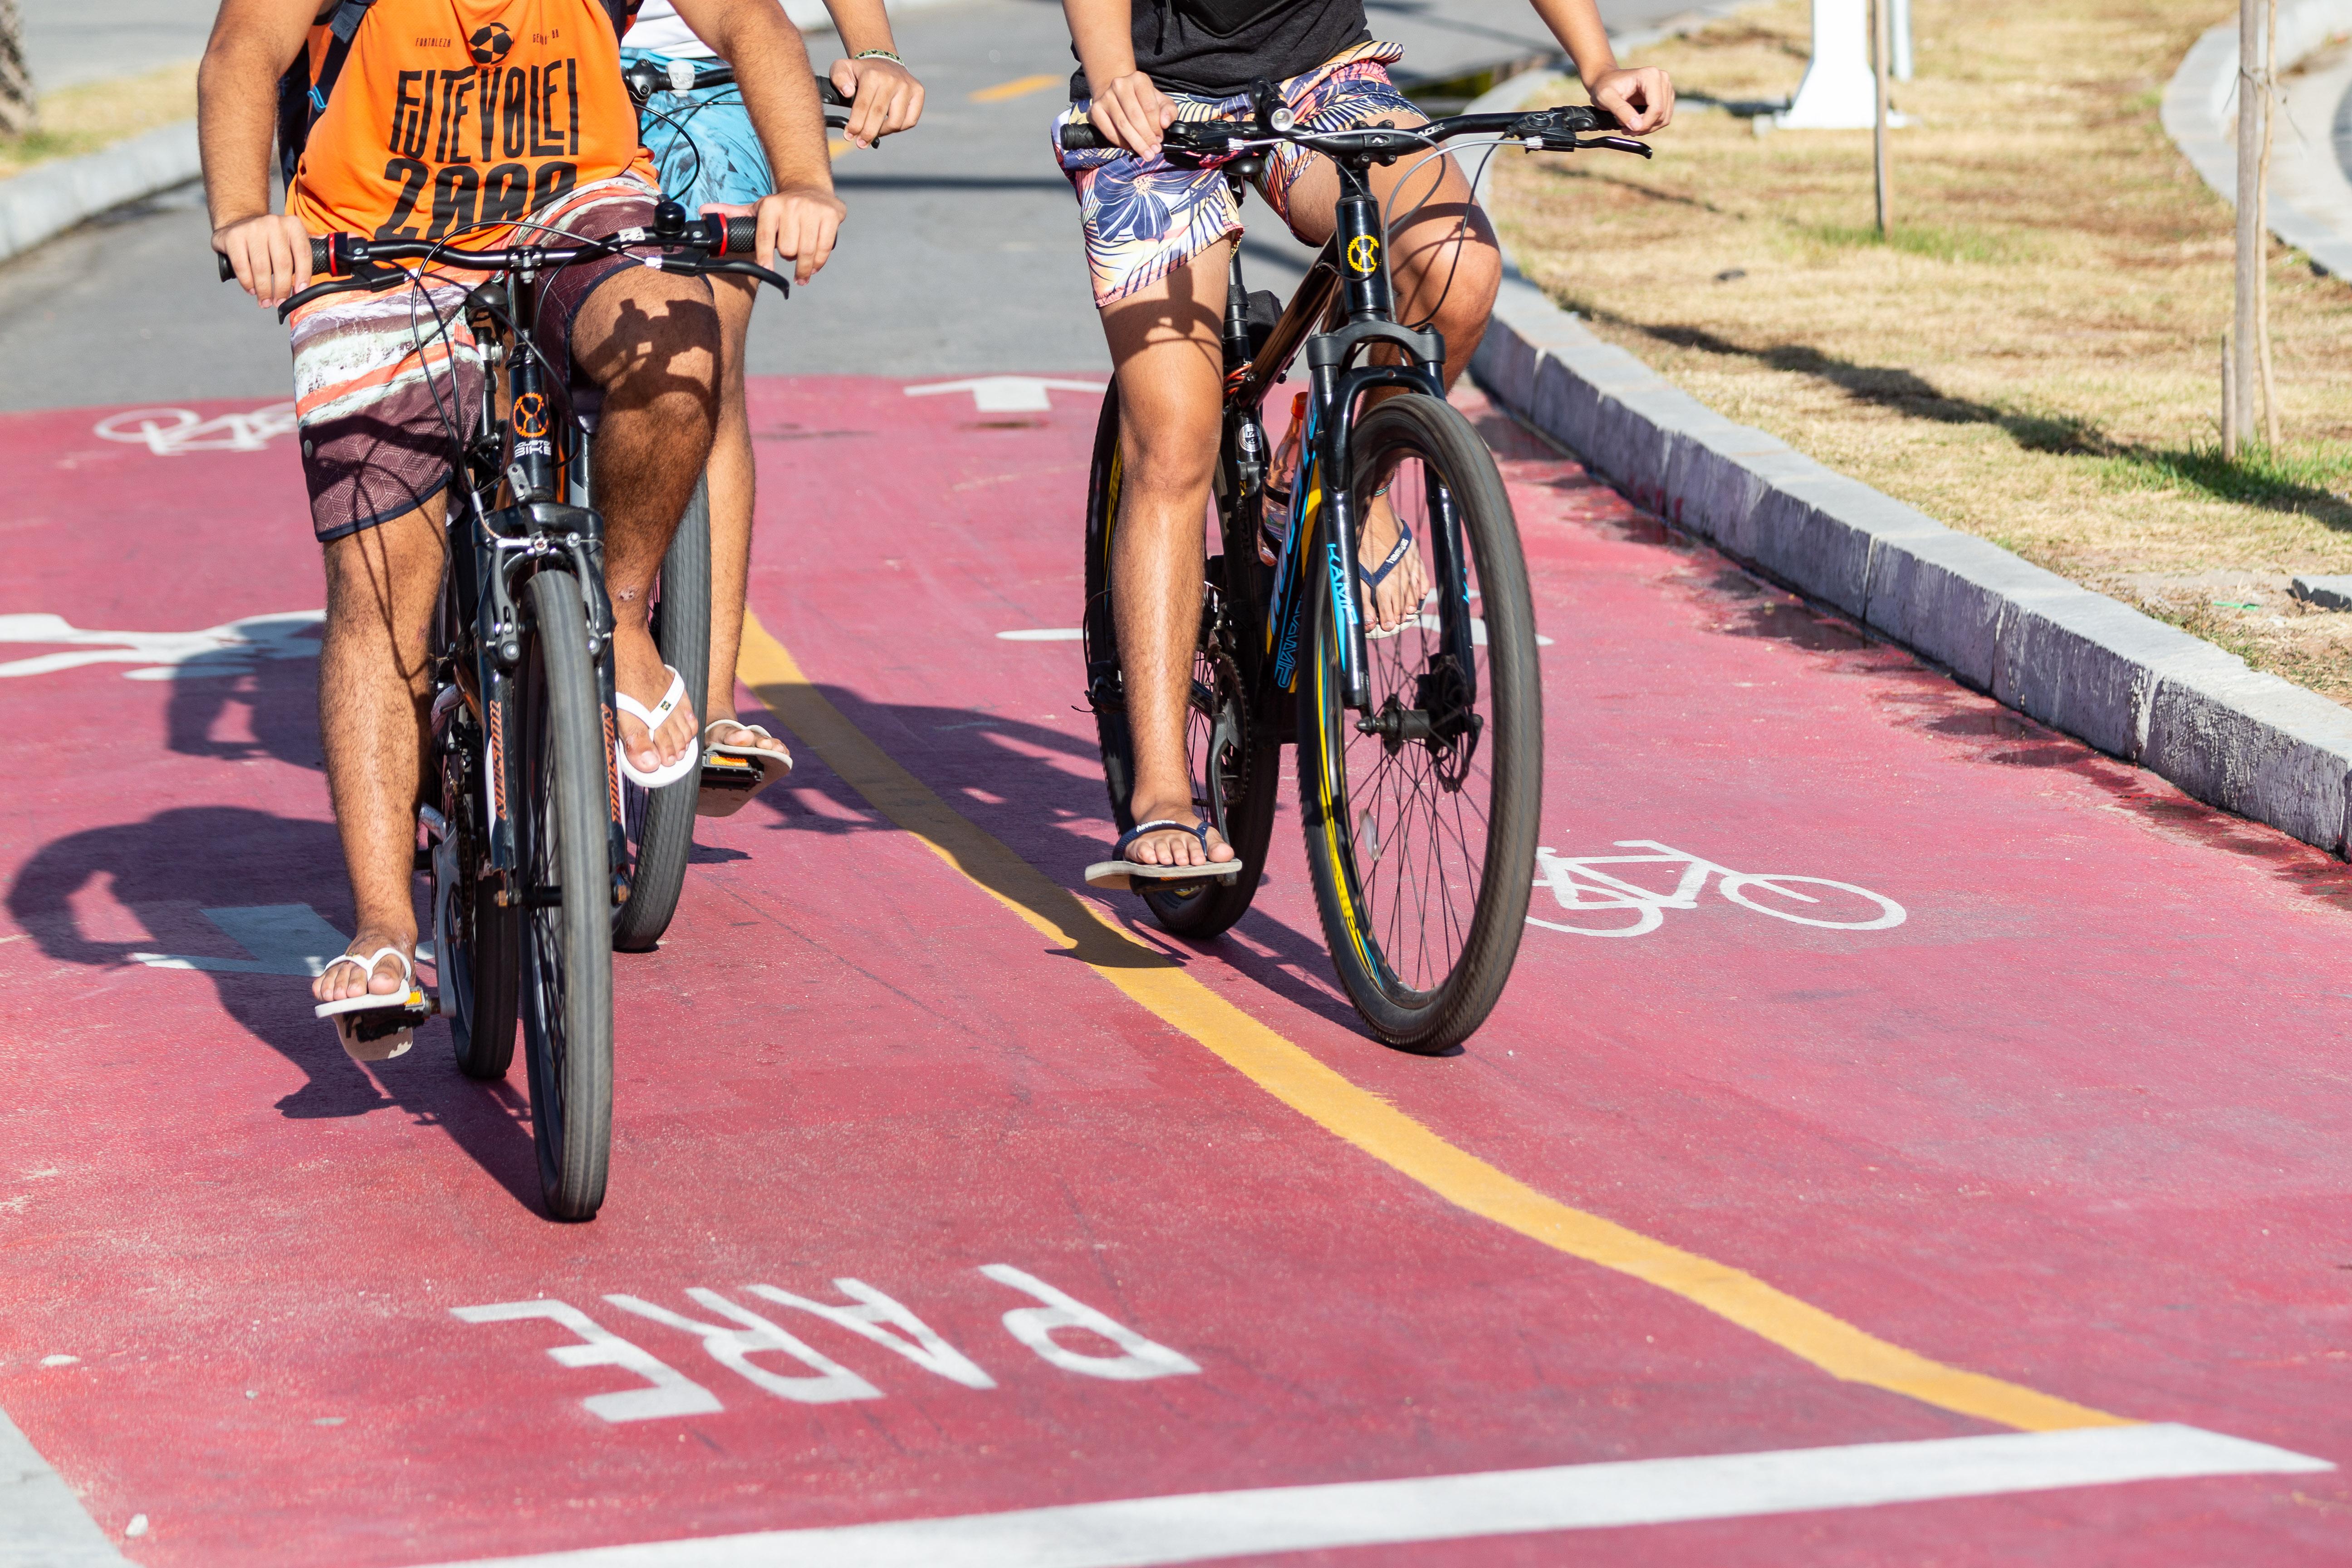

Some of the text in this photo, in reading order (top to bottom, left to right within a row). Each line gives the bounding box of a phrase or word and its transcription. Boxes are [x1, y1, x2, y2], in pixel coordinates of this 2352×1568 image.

[415, 38, 451, 48] FORTALEZA
[514, 445, 551, 458] BIKE
[444, 1262, 1204, 1424] PARE
